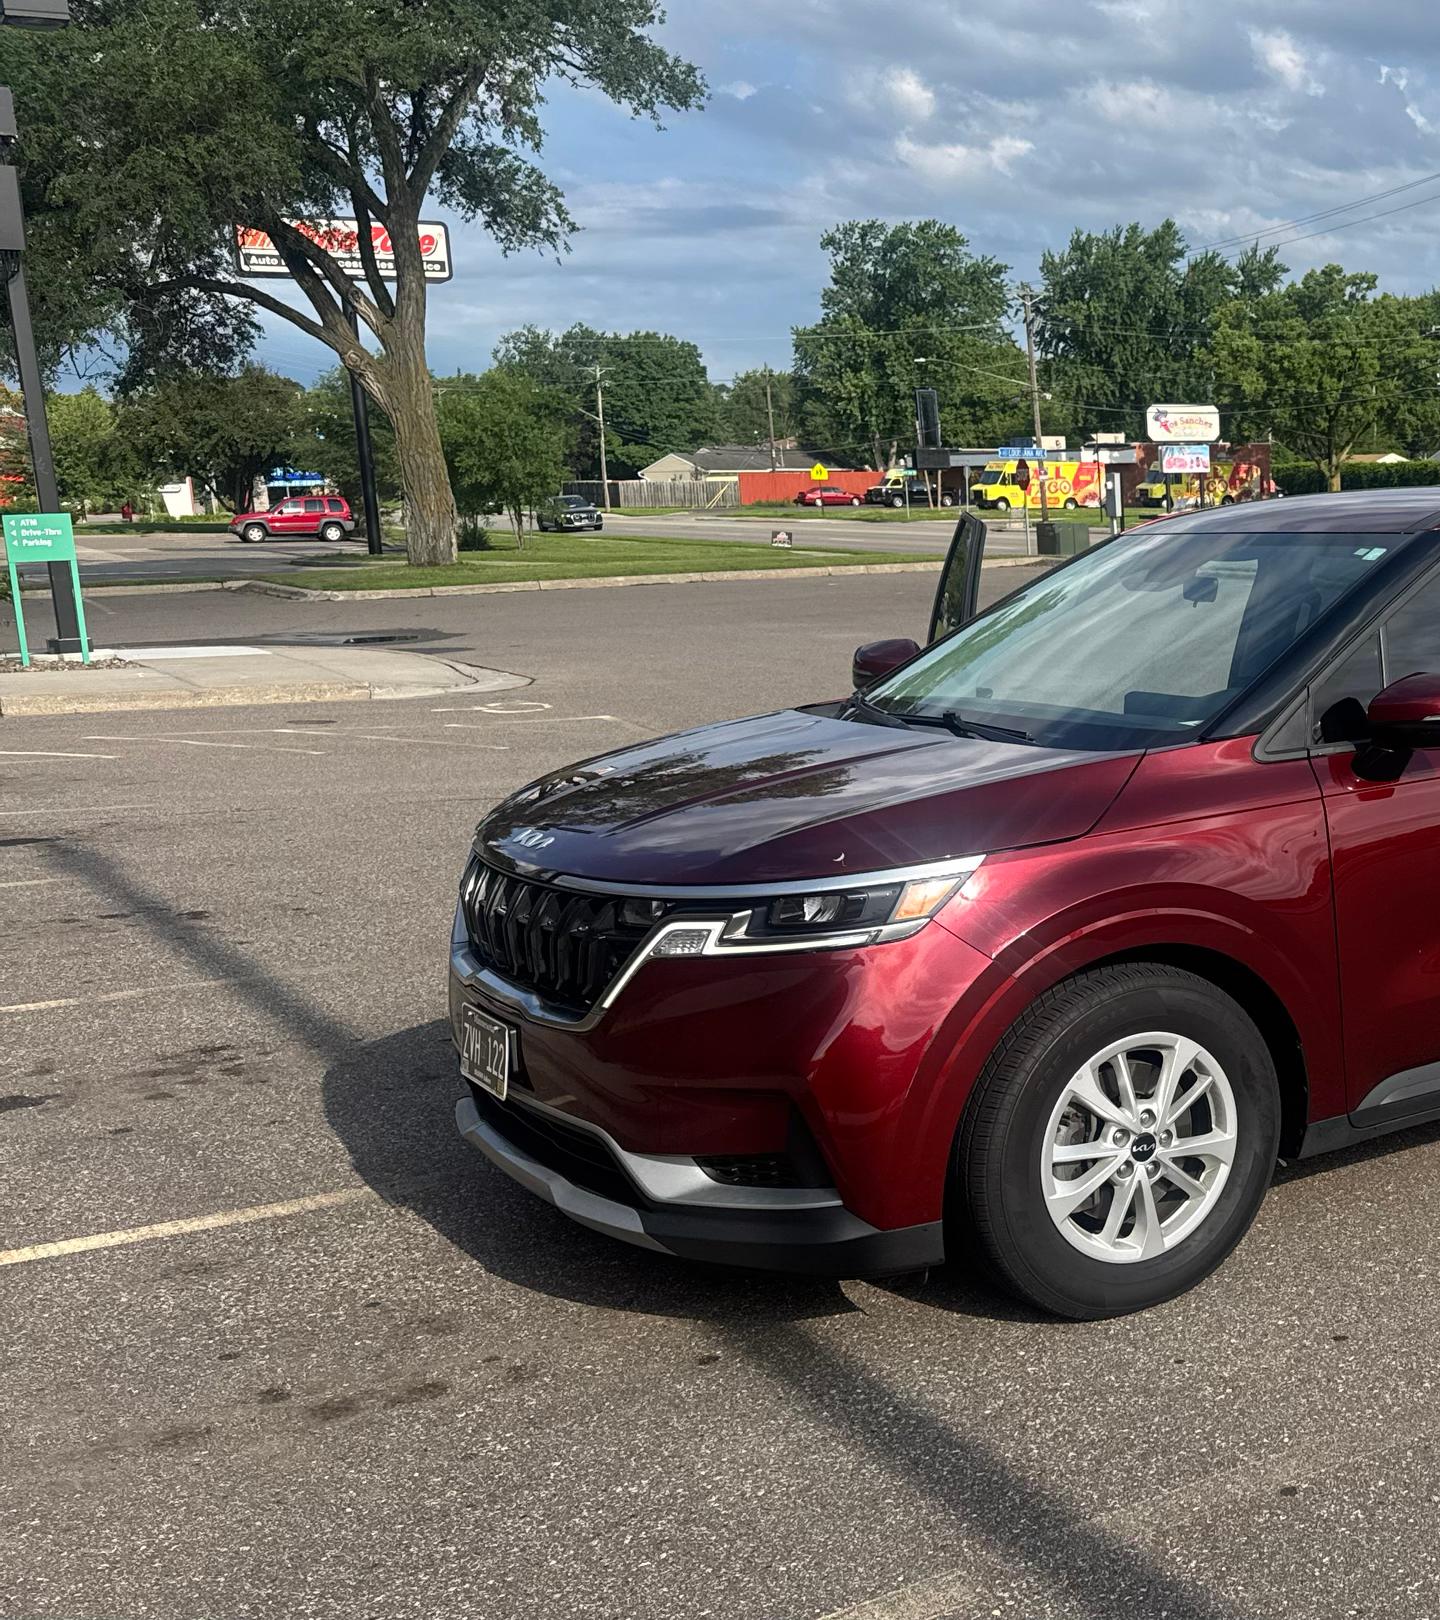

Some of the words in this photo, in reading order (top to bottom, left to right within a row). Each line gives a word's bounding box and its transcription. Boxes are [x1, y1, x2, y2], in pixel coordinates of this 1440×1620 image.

[250, 254, 279, 267] Auto
[20, 518, 38, 527] ATM
[21, 528, 62, 536] Drive-Thru
[22, 538, 53, 547] Parking
[463, 1022, 481, 1066] ZVH
[486, 1036, 505, 1080] 122
[1132, 1142, 1155, 1153] KIA
